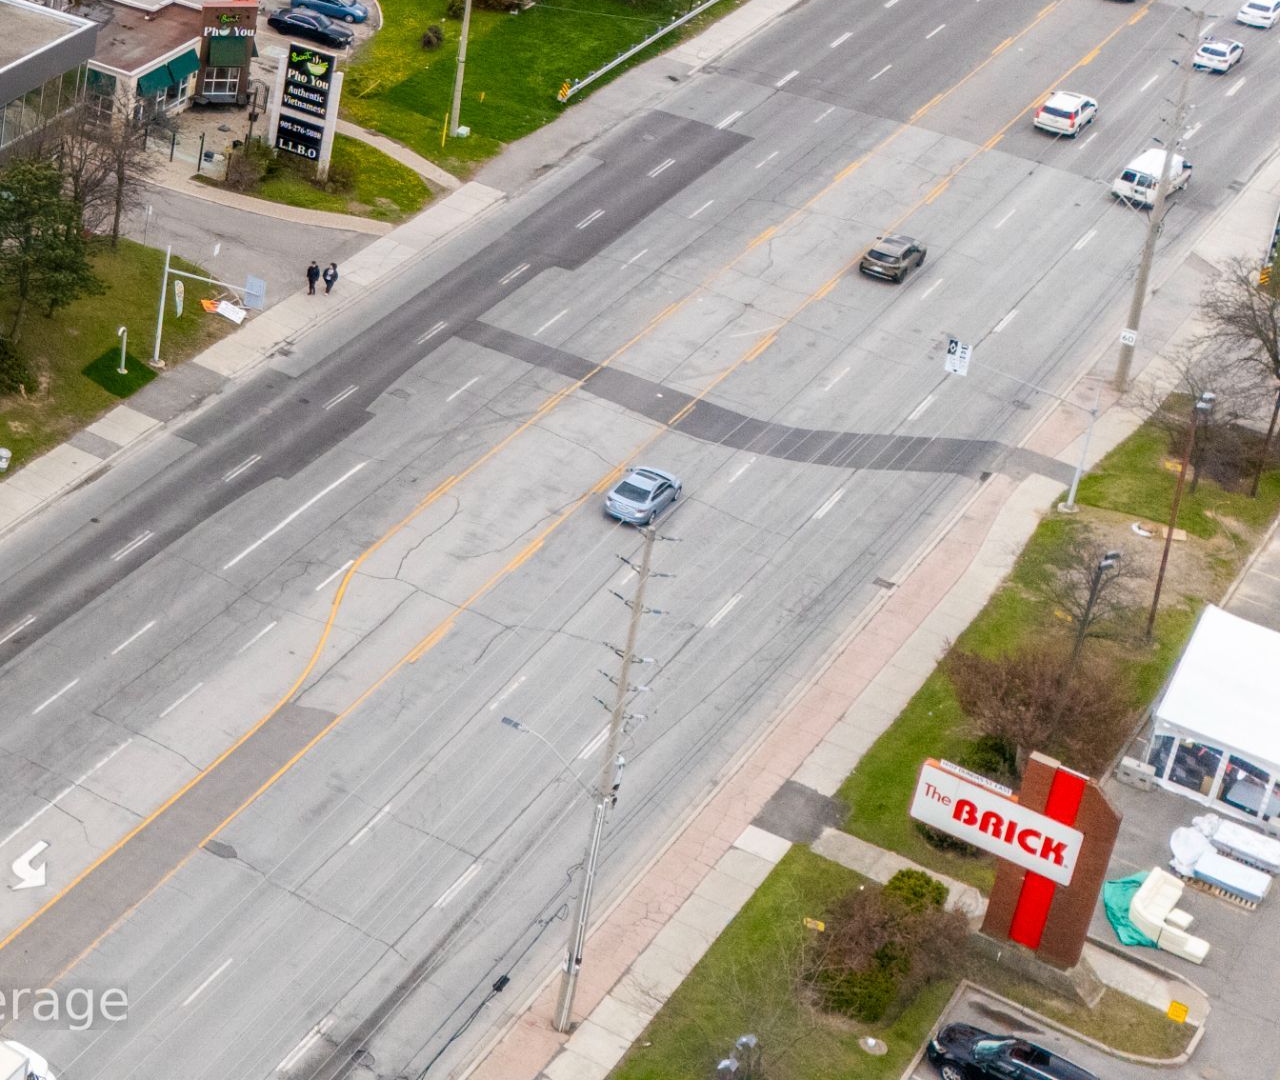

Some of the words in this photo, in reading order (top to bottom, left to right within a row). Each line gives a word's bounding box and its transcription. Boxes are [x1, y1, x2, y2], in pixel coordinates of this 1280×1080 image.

[234, 25, 255, 37] You
[287, 68, 308, 83] Pho
[311, 75, 329, 90] You
[287, 85, 324, 103] Authentic
[283, 94, 326, 115] Vietnamese
[1122, 334, 1134, 344] 60
[924, 781, 952, 807] The
[952, 798, 1068, 867] BRICK
